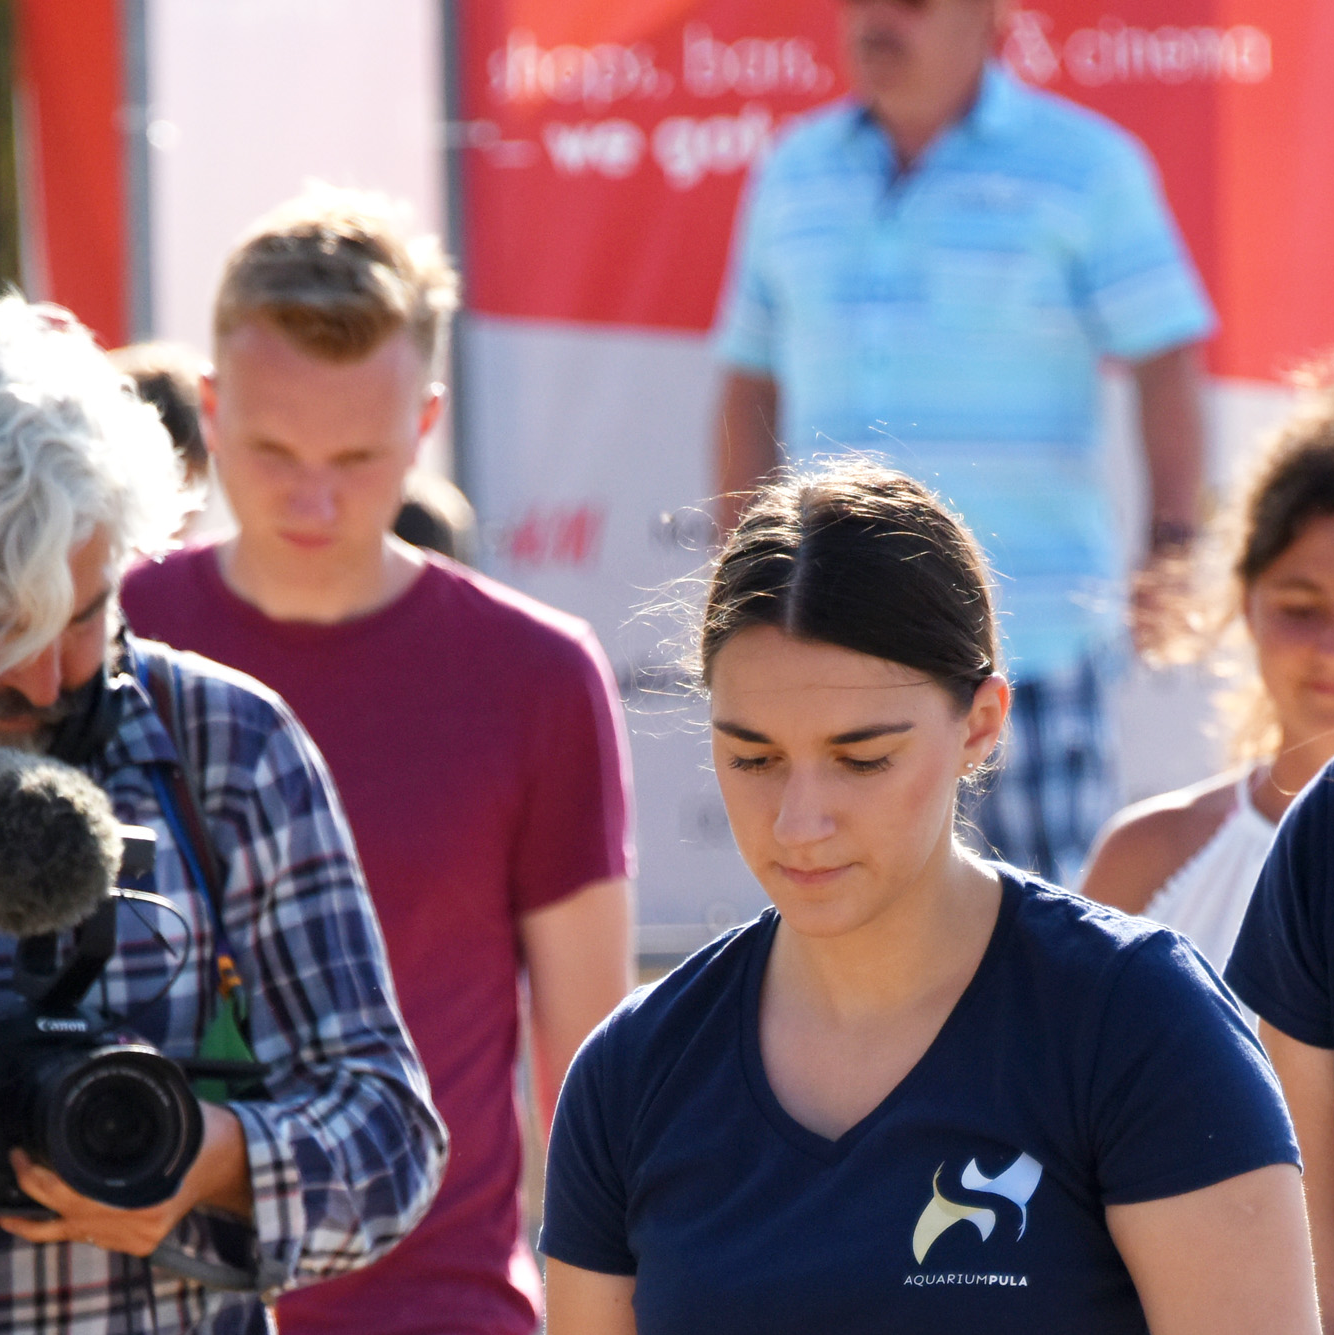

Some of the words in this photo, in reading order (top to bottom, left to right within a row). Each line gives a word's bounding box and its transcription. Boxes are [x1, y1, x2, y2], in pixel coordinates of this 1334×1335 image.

[1064, 15, 1272, 87] cinema
[542, 119, 648, 180] we
[36, 1016, 88, 1032] Canon
[903, 1273, 1028, 1287] AQUARIUMPULA
